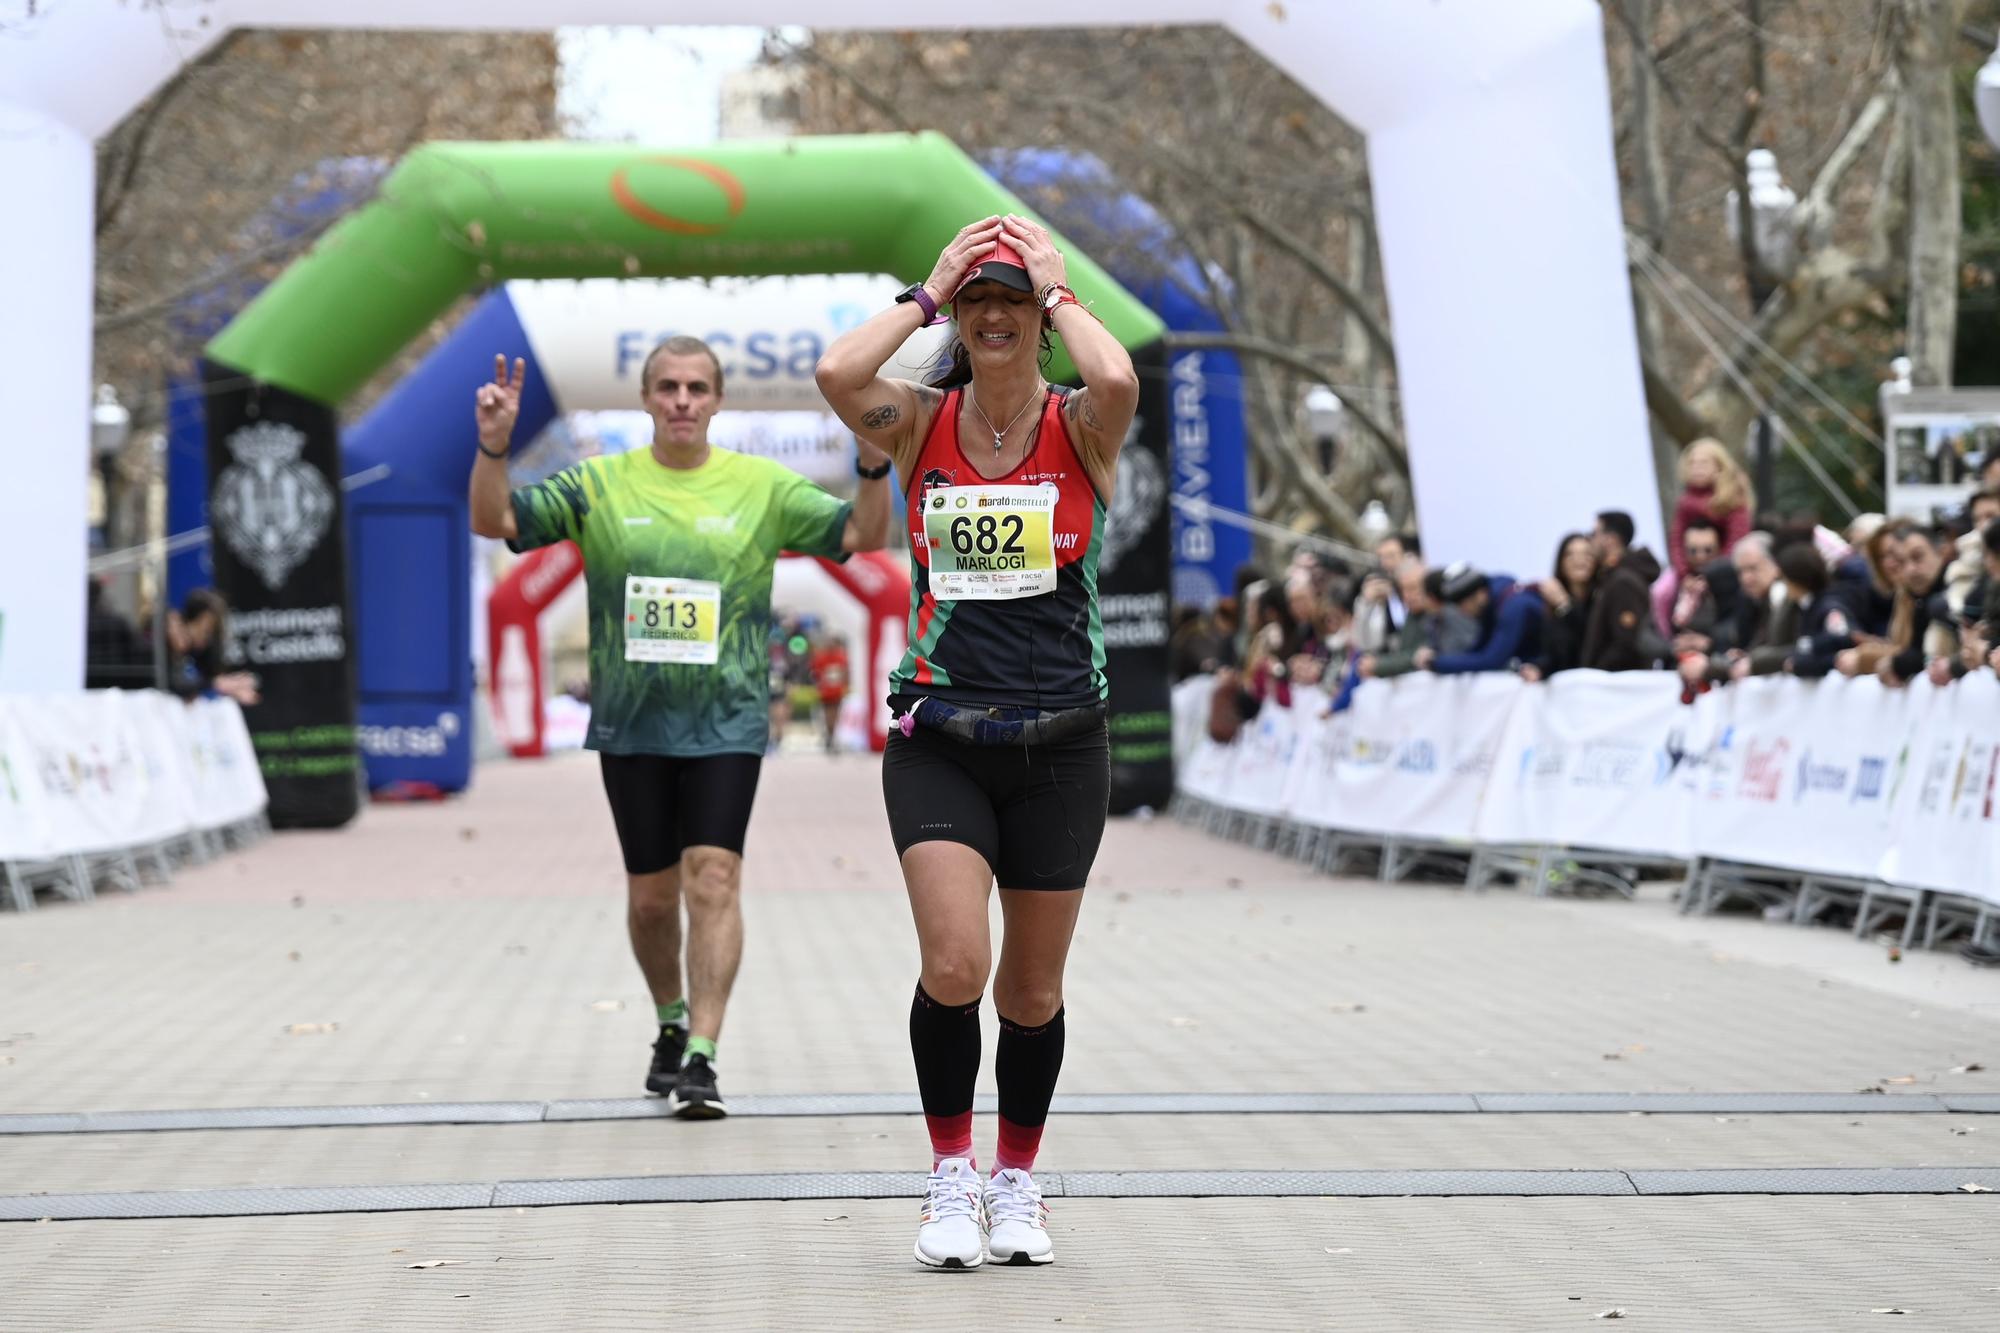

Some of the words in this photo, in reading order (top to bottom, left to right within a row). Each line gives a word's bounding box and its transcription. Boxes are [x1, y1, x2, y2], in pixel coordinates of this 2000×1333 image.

[950, 514, 1025, 555] 682
[956, 556, 1026, 570] MARLOGI
[645, 601, 697, 628] 813
[641, 628, 699, 640] FEDERICO
